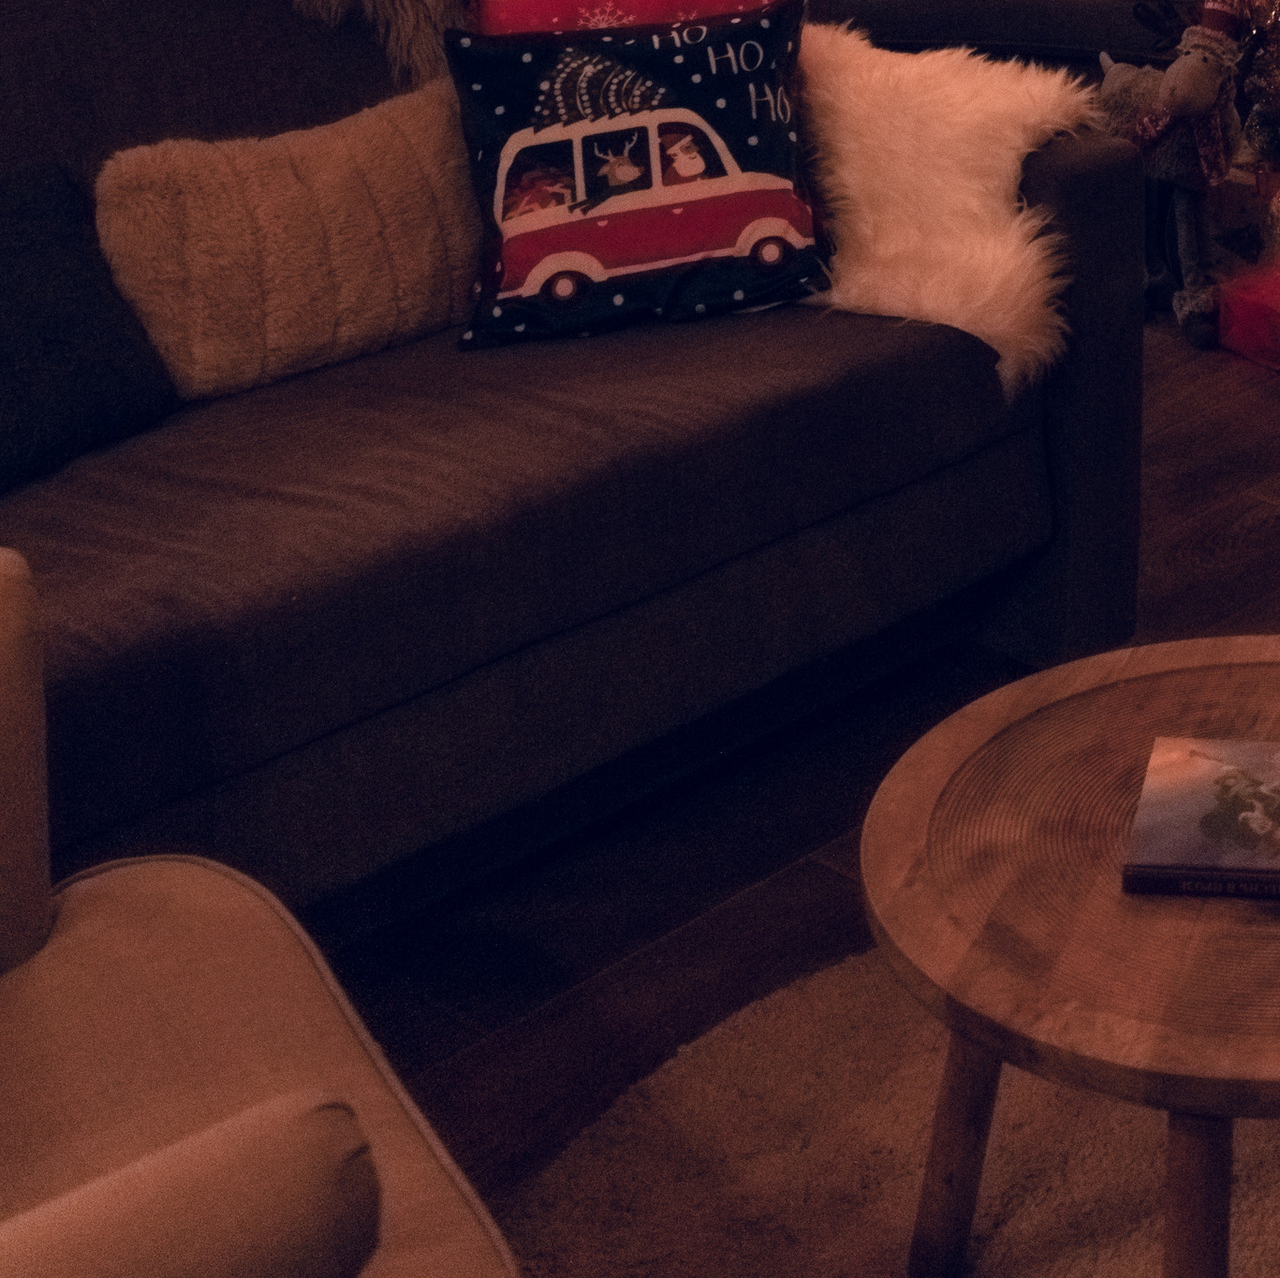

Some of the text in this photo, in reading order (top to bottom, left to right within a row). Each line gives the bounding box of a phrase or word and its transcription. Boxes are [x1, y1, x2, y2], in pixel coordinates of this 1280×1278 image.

[652, 25, 707, 50] HO
[707, 40, 764, 75] HO
[749, 82, 791, 124] HO
